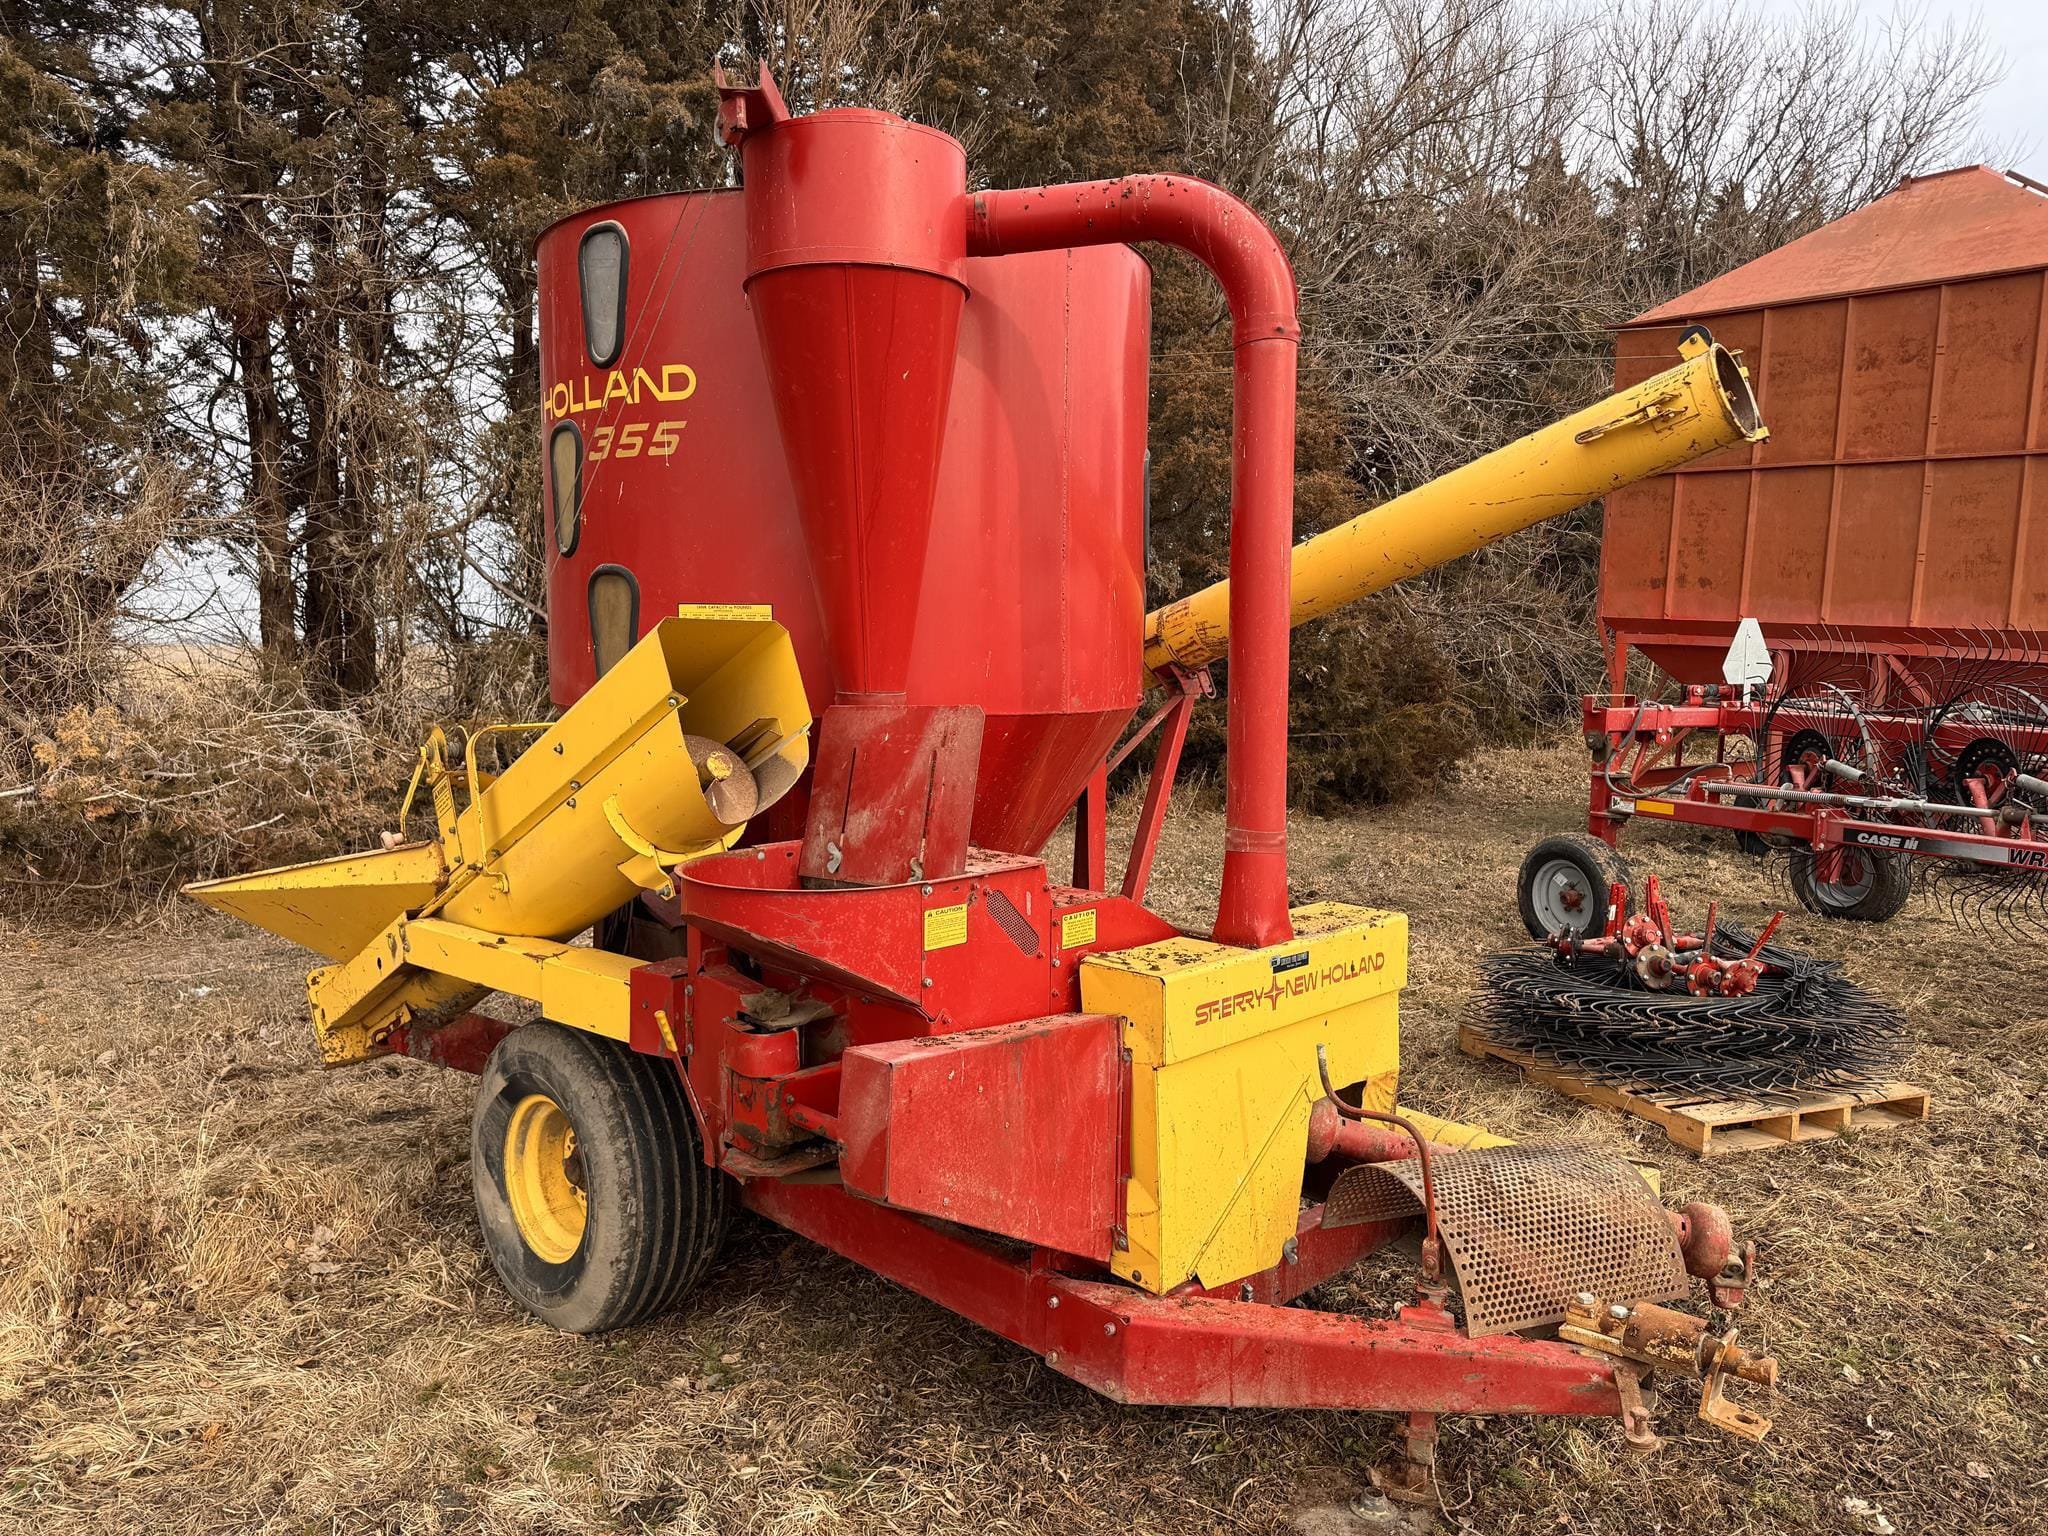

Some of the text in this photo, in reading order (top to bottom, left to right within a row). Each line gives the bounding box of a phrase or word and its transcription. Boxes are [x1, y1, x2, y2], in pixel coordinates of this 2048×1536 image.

[543, 364, 697, 424] HOLLAND
[588, 420, 688, 461] 355
[1857, 832, 1902, 848] CASE
[935, 906, 964, 916] CAUTION
[1063, 911, 1095, 921] CAUTION
[1285, 970, 1319, 998] NEW
[1320, 952, 1385, 988] HOLLAND
